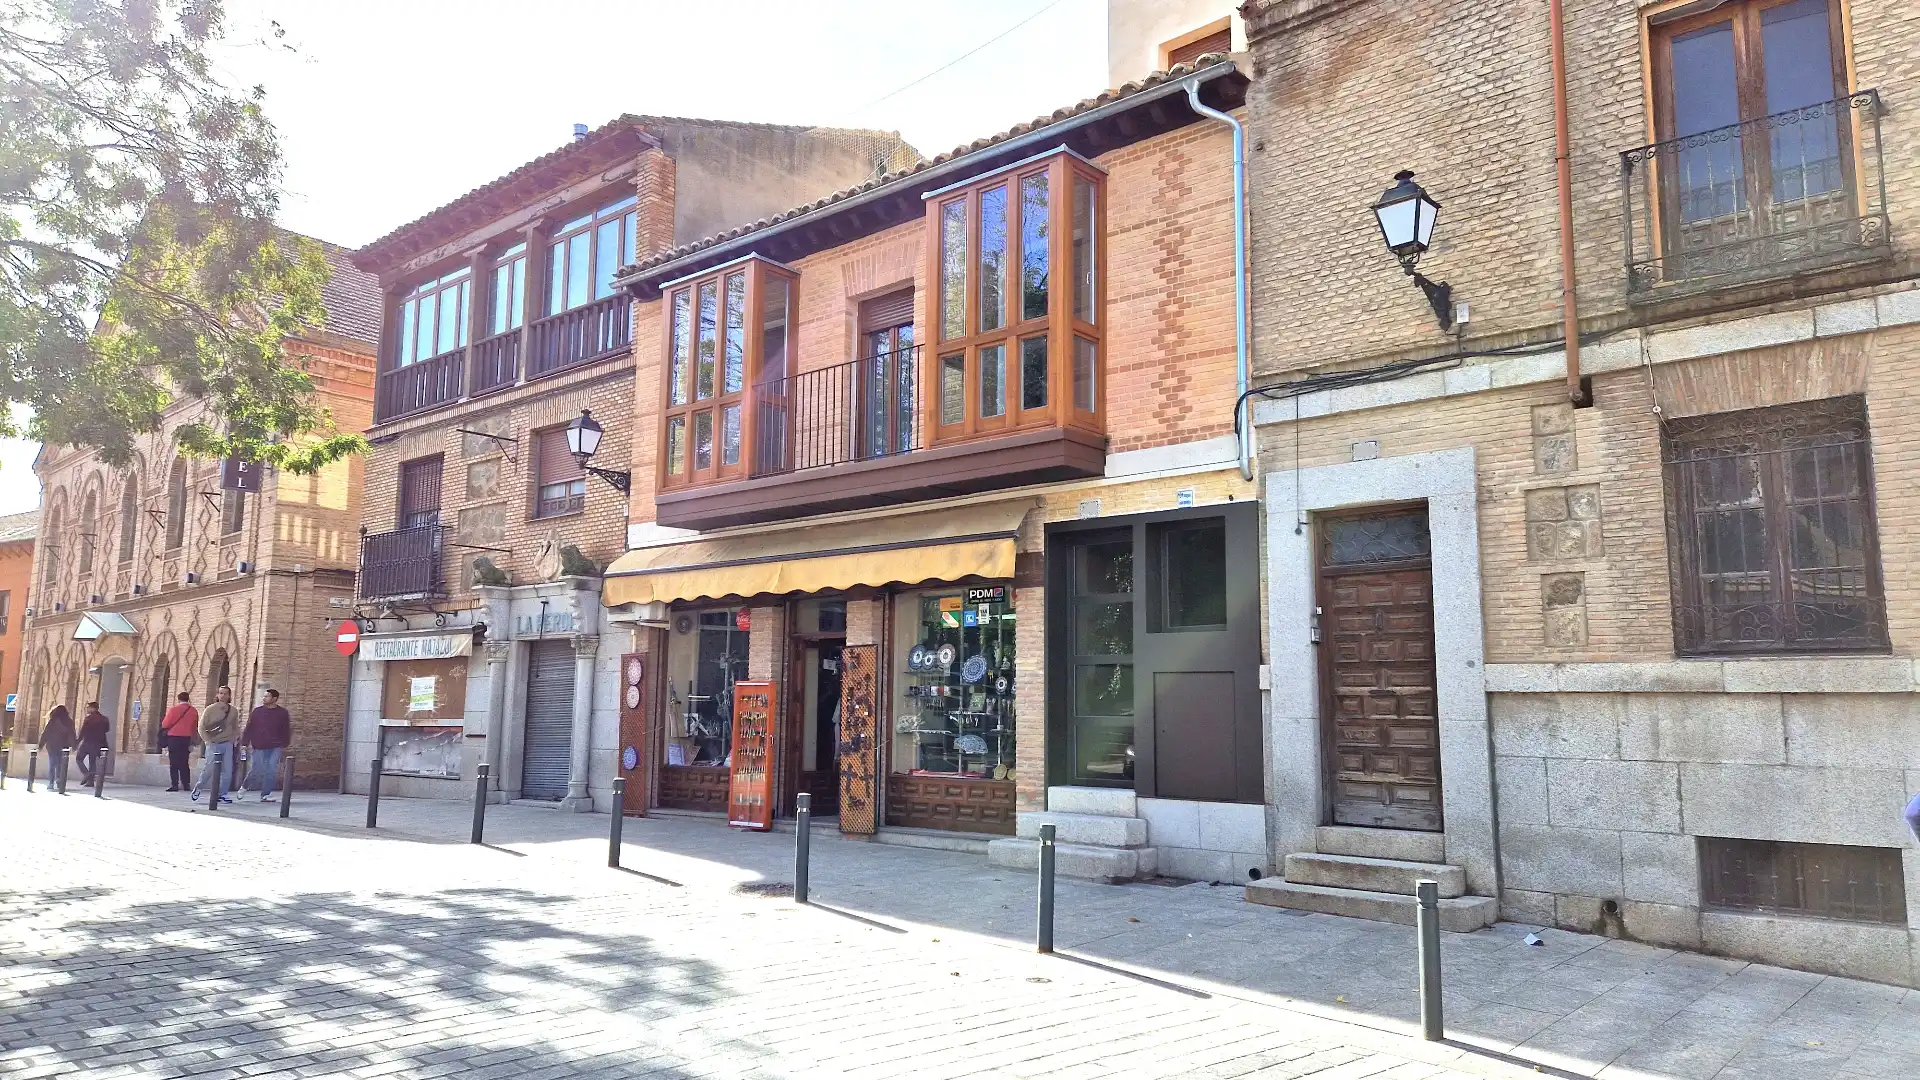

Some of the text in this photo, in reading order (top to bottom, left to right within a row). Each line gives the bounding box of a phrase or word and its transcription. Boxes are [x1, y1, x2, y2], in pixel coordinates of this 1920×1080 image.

[969, 589, 993, 599] PDM
[516, 616, 533, 634] LA
[374, 640, 418, 658] RESTAURANTE
